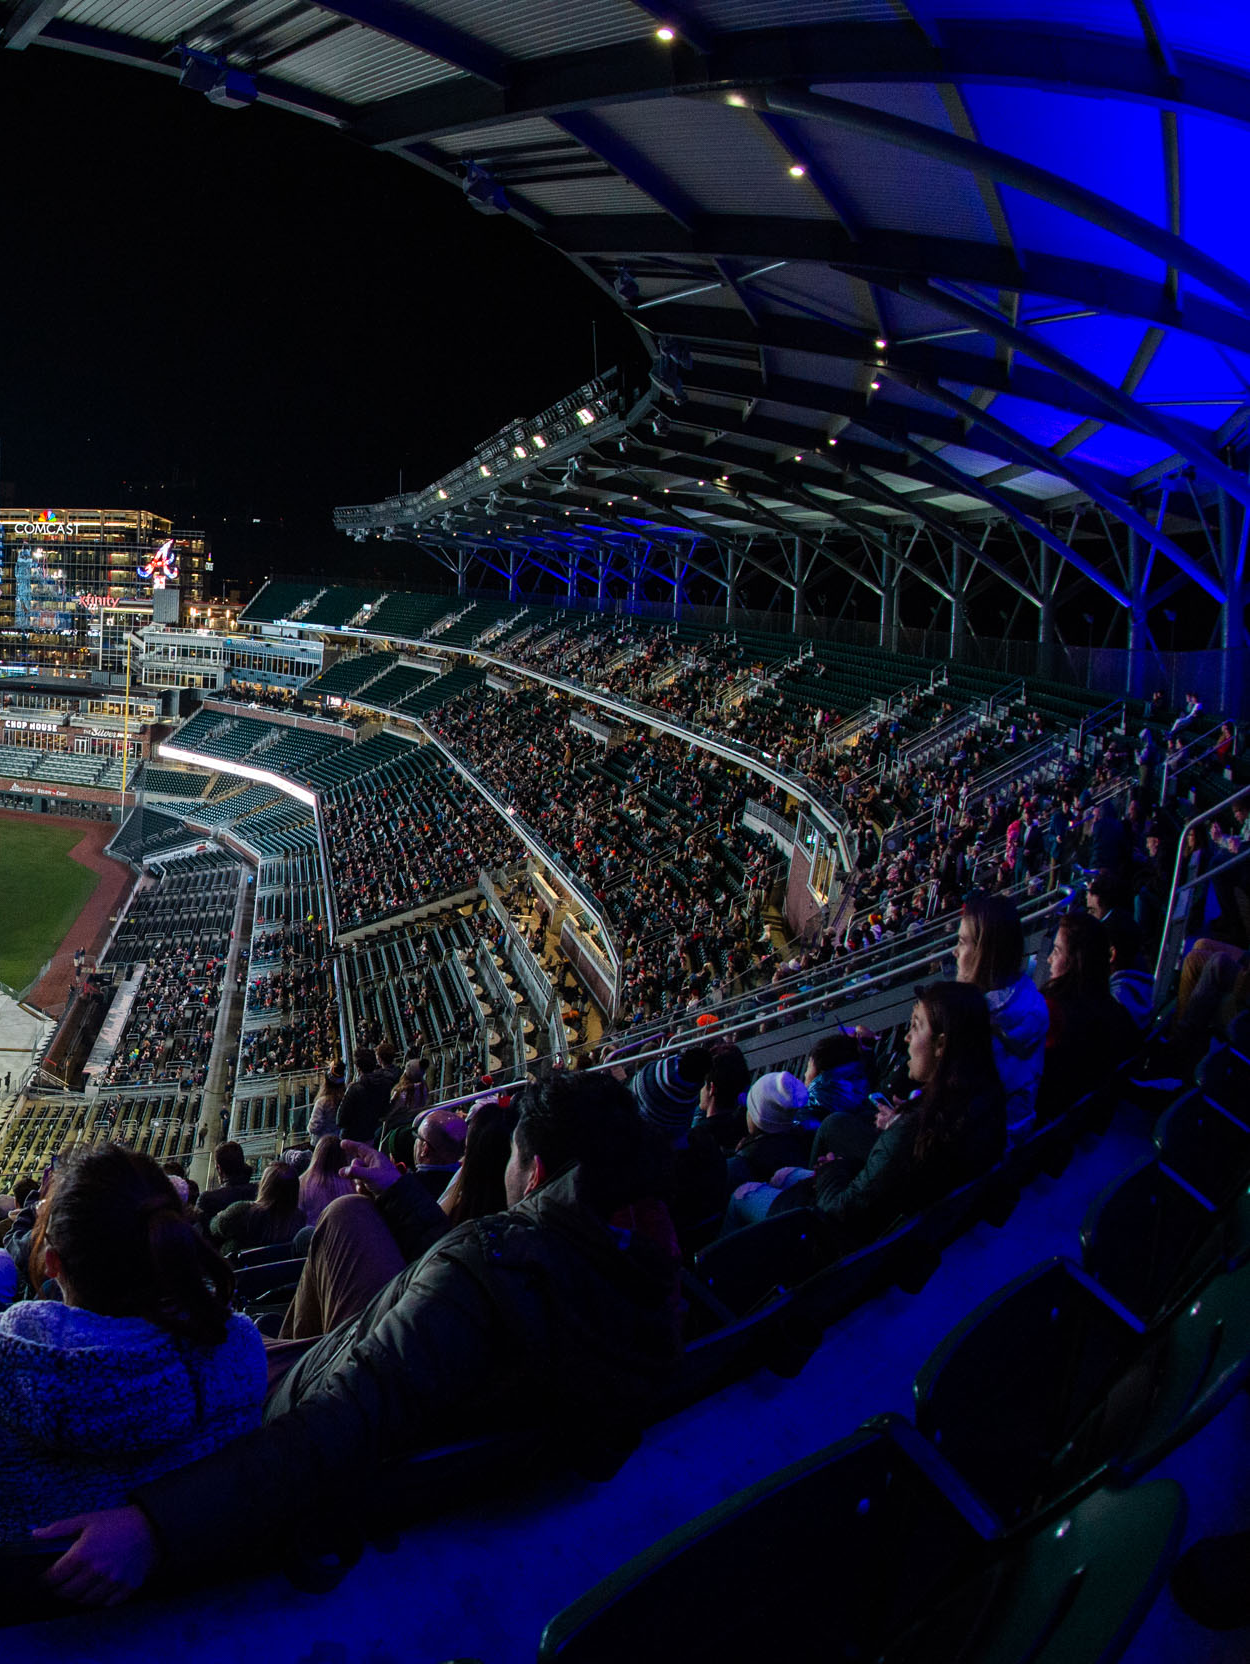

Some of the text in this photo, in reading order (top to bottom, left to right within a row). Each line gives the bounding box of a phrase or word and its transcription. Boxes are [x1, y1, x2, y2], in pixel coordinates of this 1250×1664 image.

[15, 523, 80, 535] COMCAST
[79, 593, 120, 608] xfinity
[5, 720, 58, 732] CHOP HOUSE
